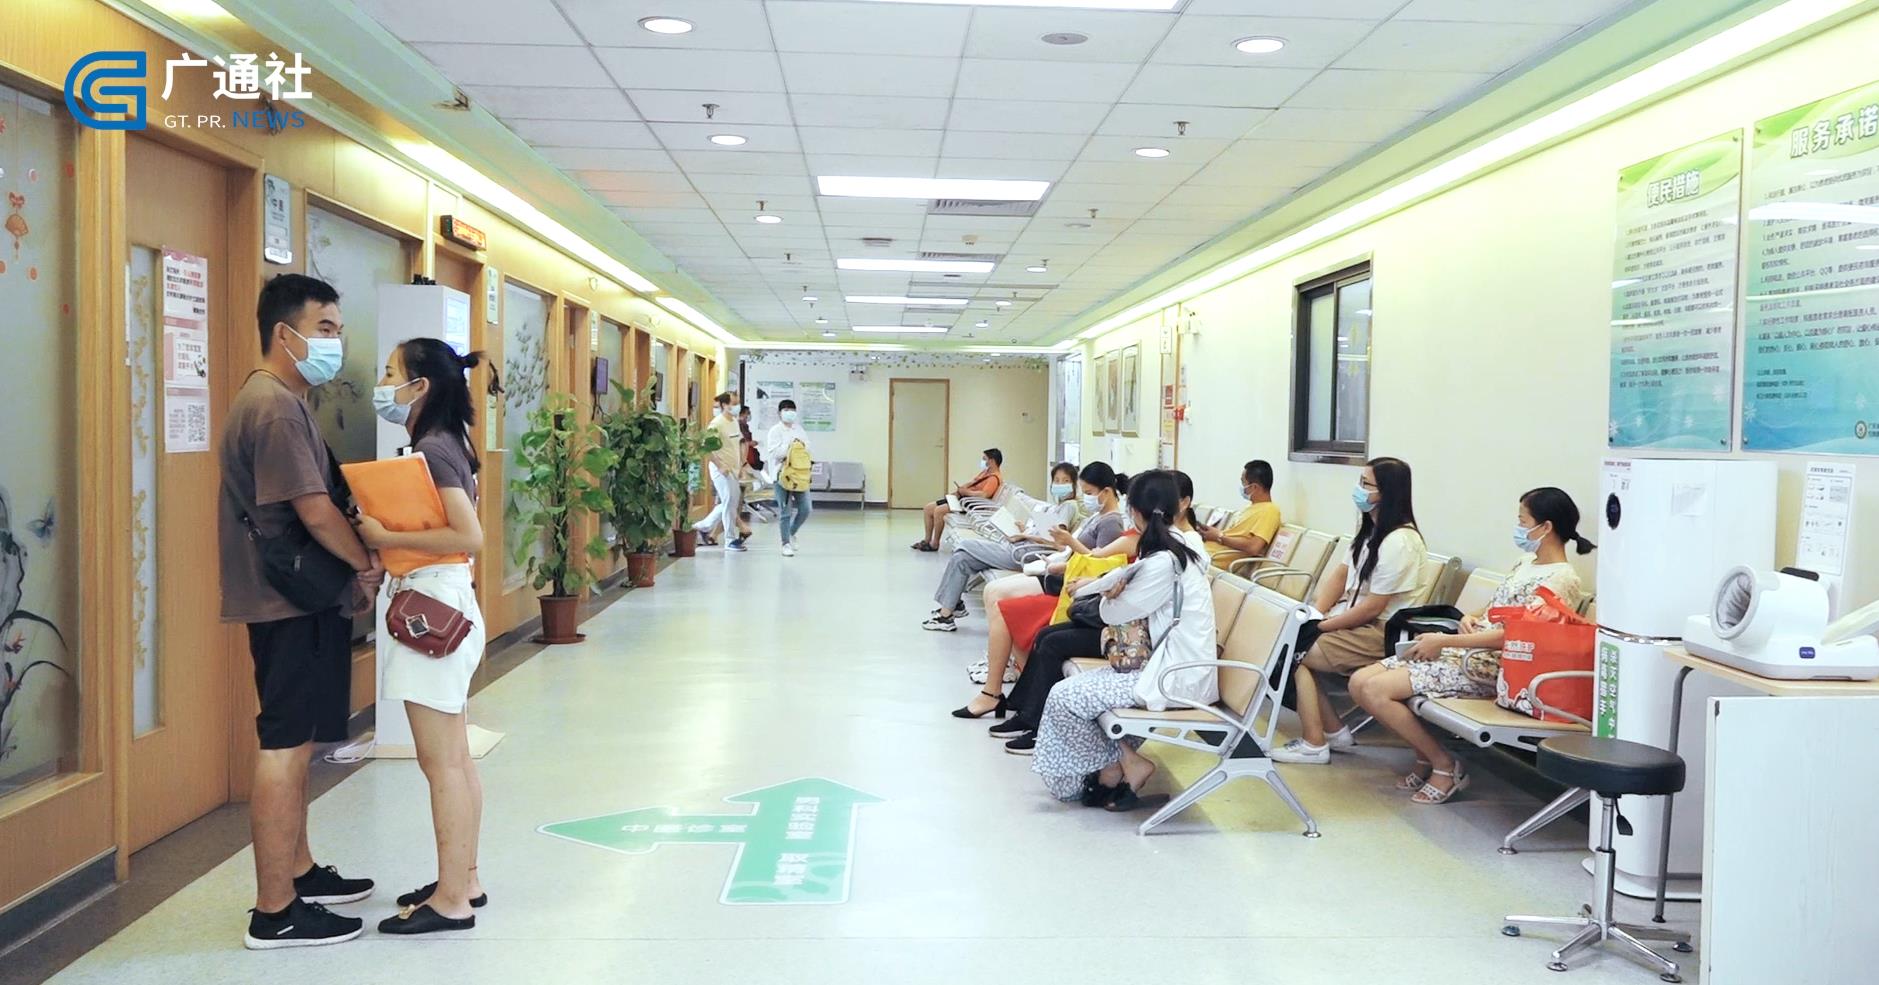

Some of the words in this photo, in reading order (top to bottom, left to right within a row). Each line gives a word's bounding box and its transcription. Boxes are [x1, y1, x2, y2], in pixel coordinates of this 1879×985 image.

[1791, 105, 1879, 158] 服务承诺
[1646, 169, 1701, 208] 便民措施
[1607, 650, 1617, 738] 杀灭空气中
